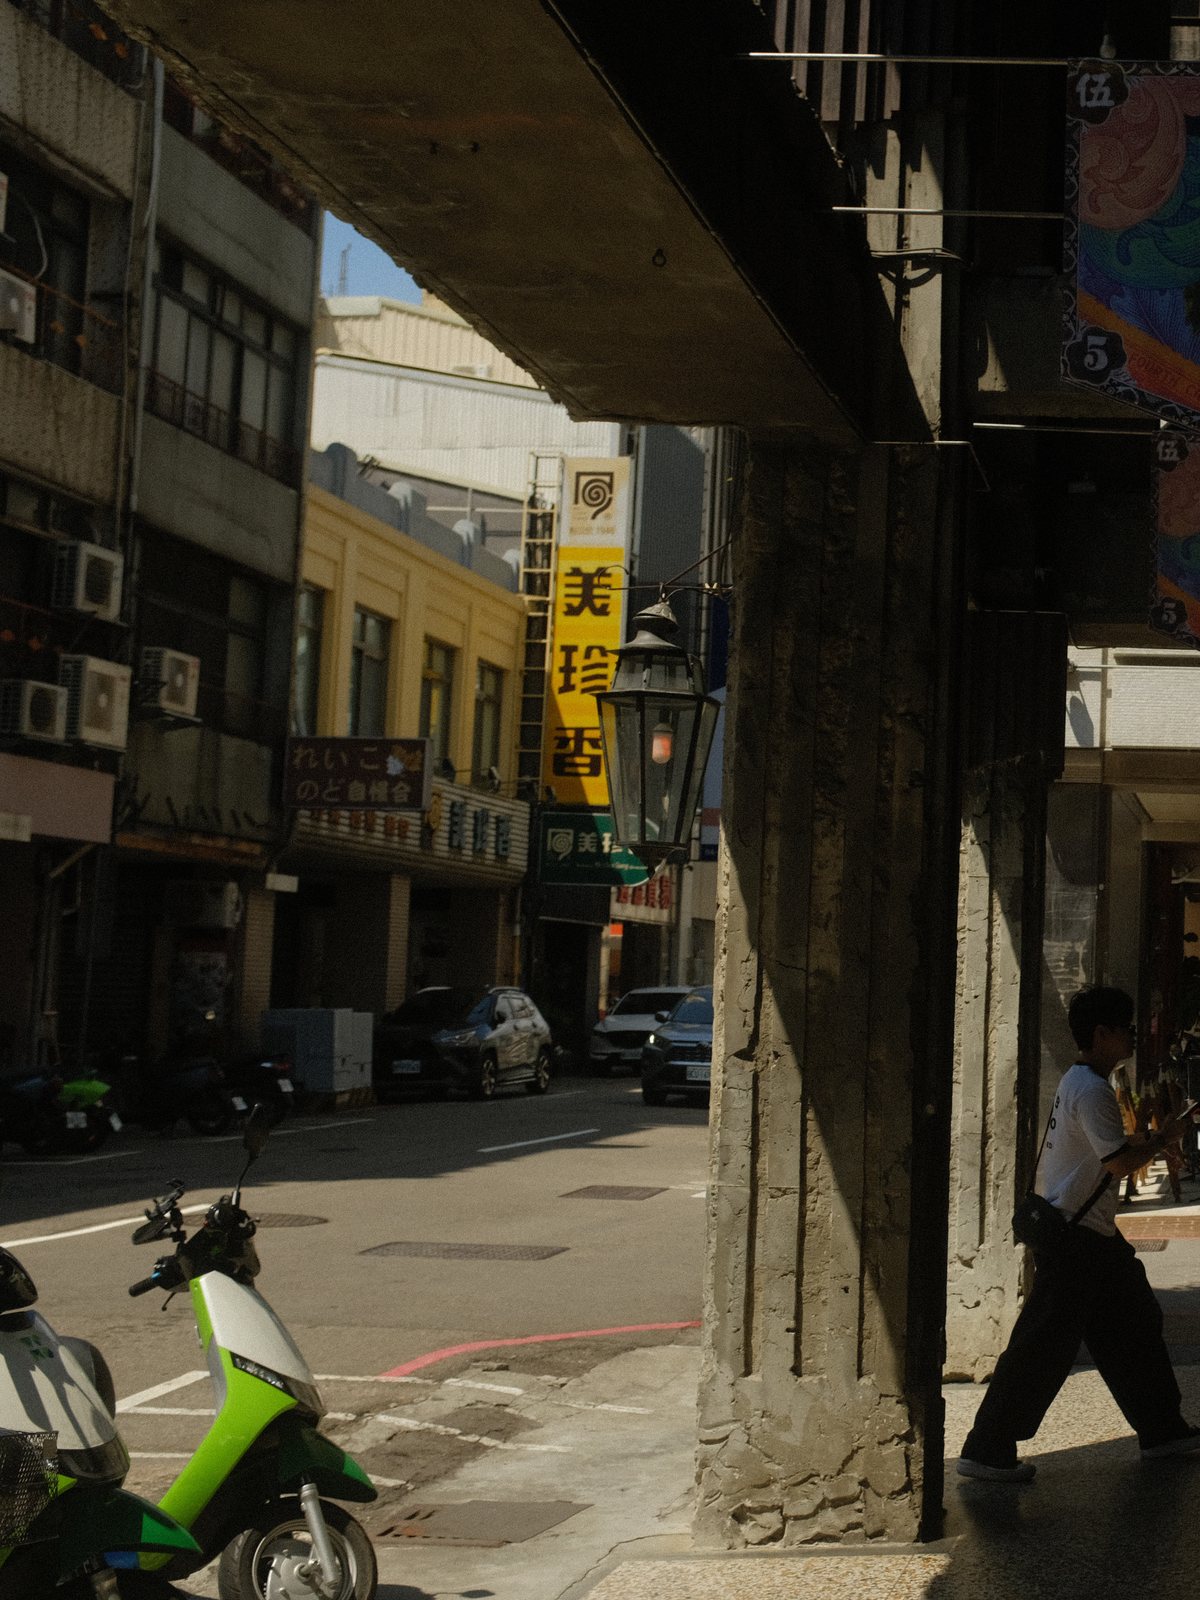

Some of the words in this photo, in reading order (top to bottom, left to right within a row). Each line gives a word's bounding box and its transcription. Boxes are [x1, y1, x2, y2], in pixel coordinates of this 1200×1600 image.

[1076, 74, 1116, 110] 伍
[1084, 336, 1109, 371] 5
[1162, 603, 1176, 624] 5
[552, 566, 612, 777] 美珍香
